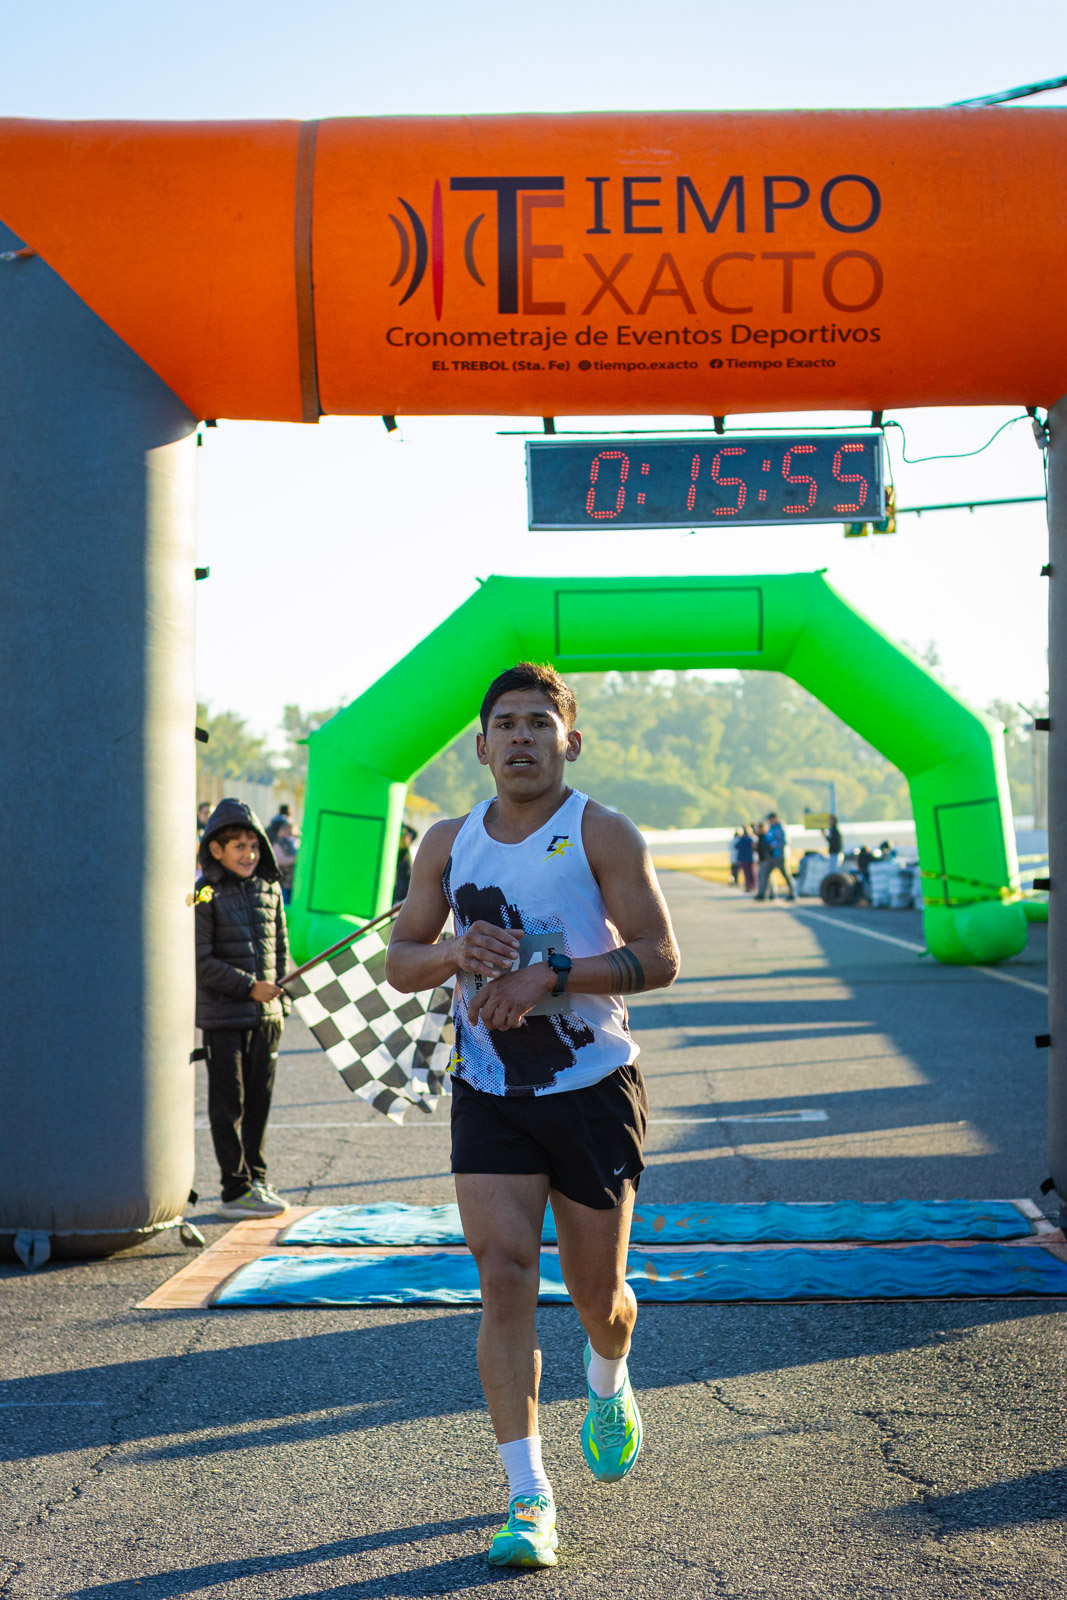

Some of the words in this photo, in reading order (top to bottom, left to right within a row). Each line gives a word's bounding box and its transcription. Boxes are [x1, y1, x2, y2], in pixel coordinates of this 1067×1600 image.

[386, 326, 567, 351] Cronometraje
[575, 325, 608, 346] de
[617, 325, 722, 345] Eventos
[731, 323, 881, 348] Deportivos
[432, 361, 449, 371] EL
[452, 361, 509, 371] TREBOL
[512, 360, 545, 372] (Sta.
[549, 360, 571, 372] Fe)
[594, 359, 698, 372] tiempo.exacto
[726, 358, 782, 370] Tiempo
[787, 357, 836, 369] Exacto
[586, 443, 867, 519] 0:15:55
